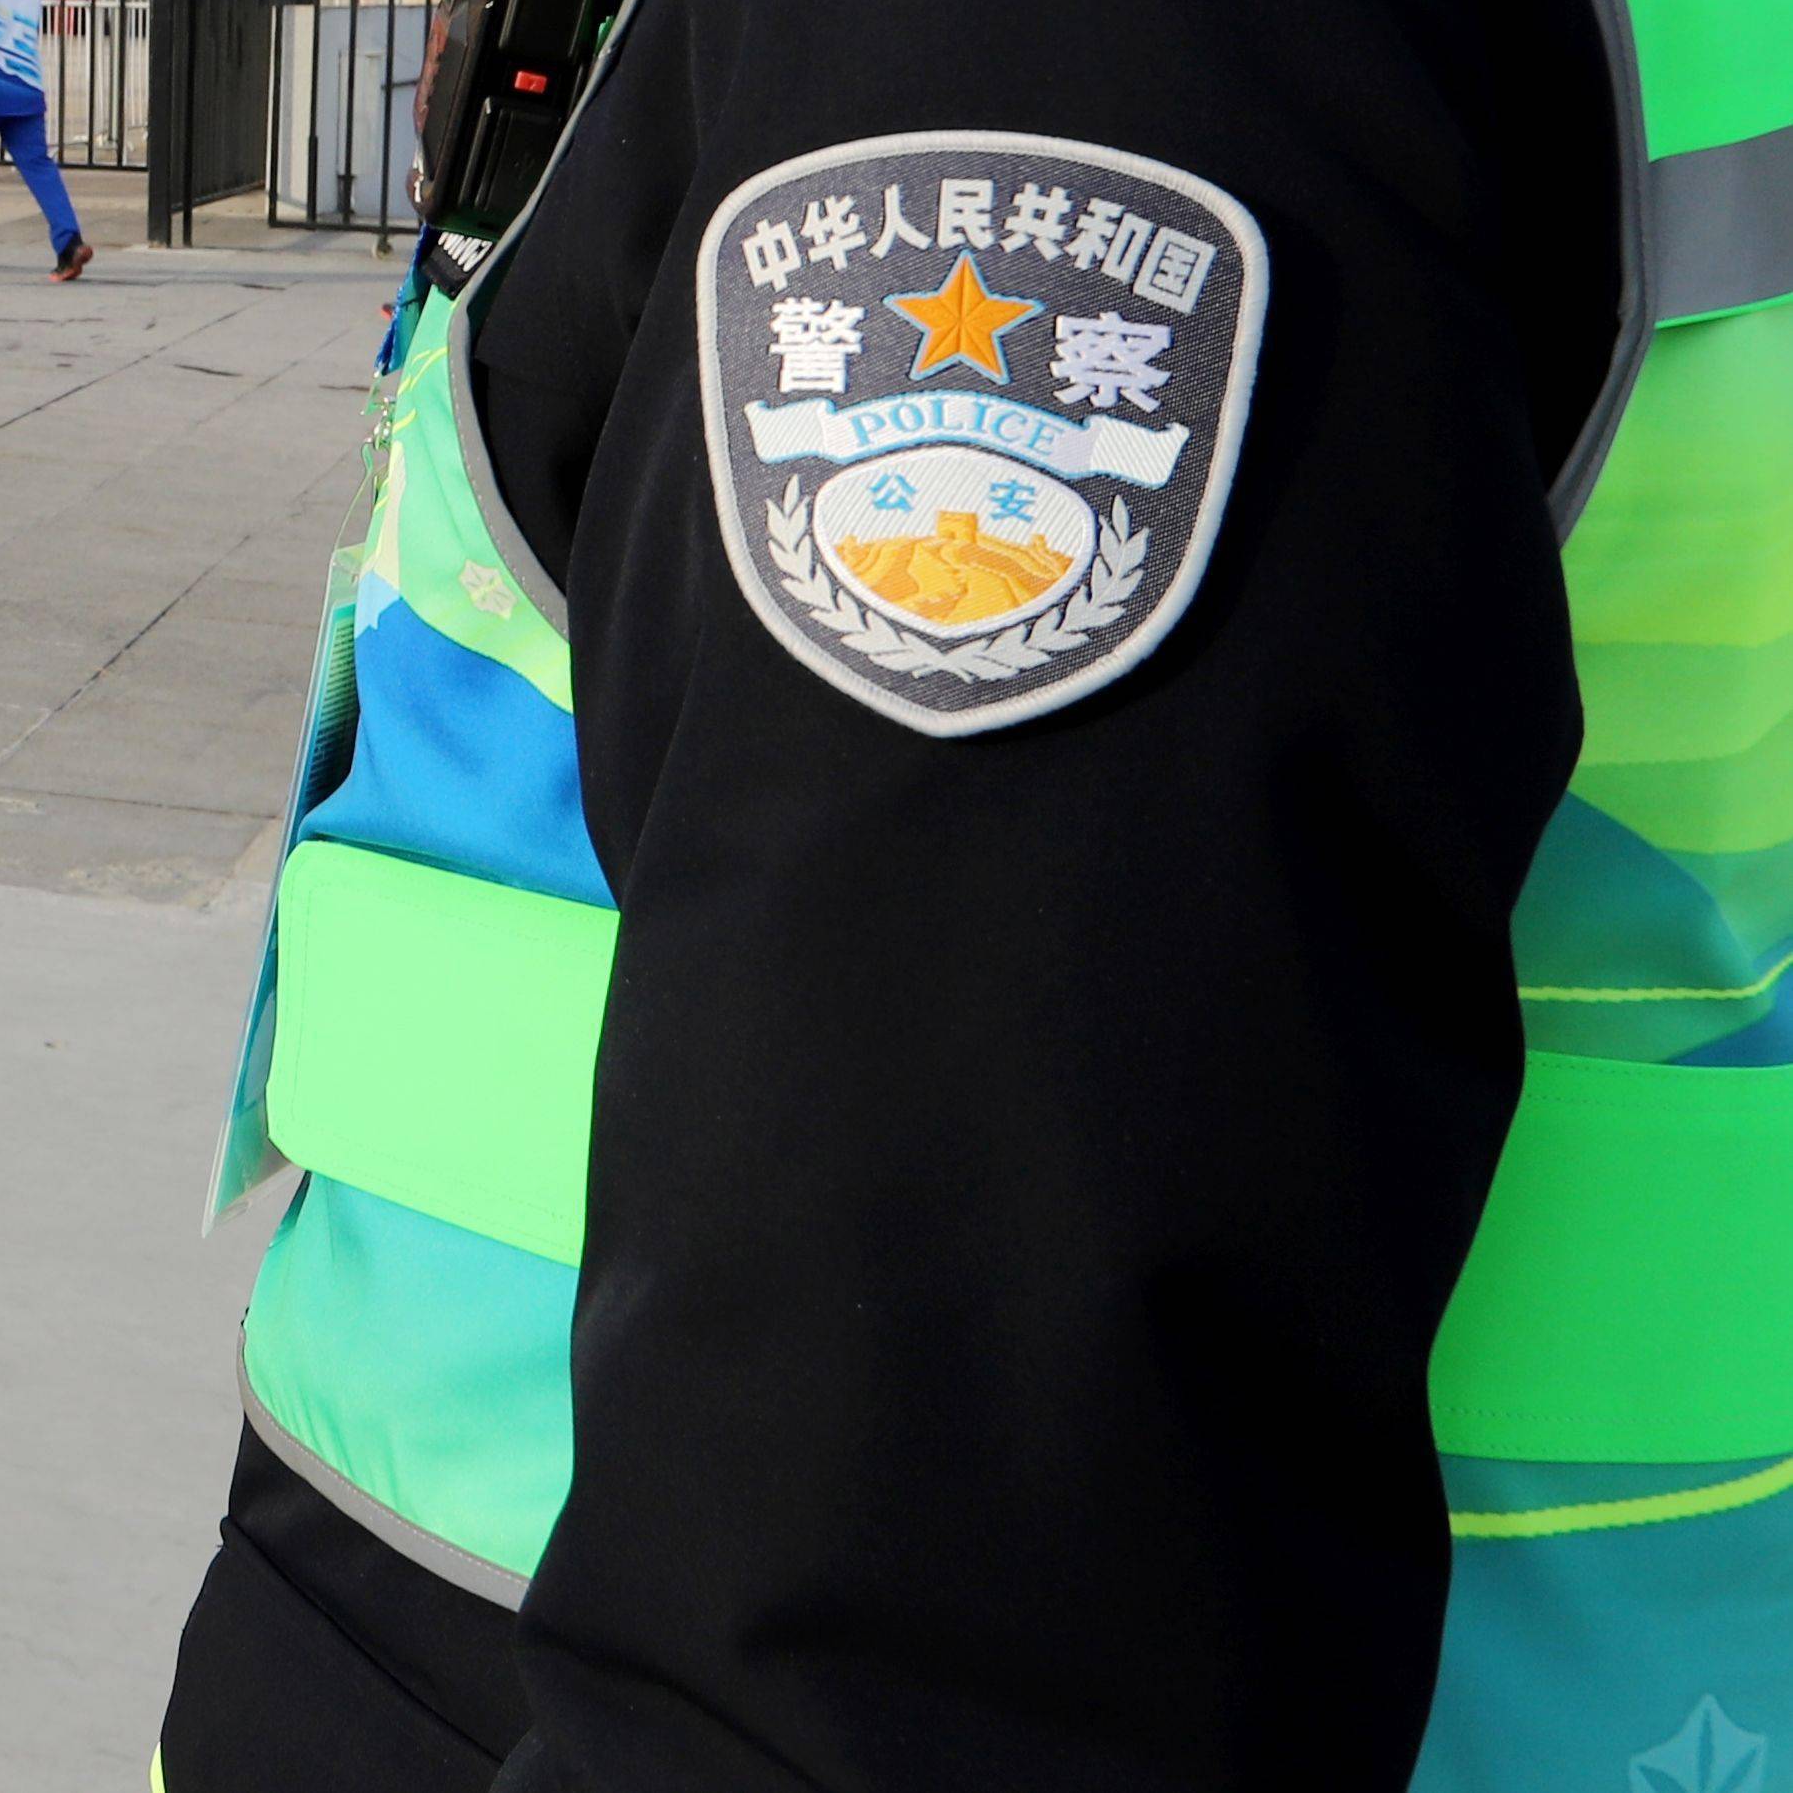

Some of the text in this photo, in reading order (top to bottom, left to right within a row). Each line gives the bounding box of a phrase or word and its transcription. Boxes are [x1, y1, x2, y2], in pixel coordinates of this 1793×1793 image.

[741, 177, 1216, 315] 中华人民共和国
[849, 394, 1065, 458] POLICE
